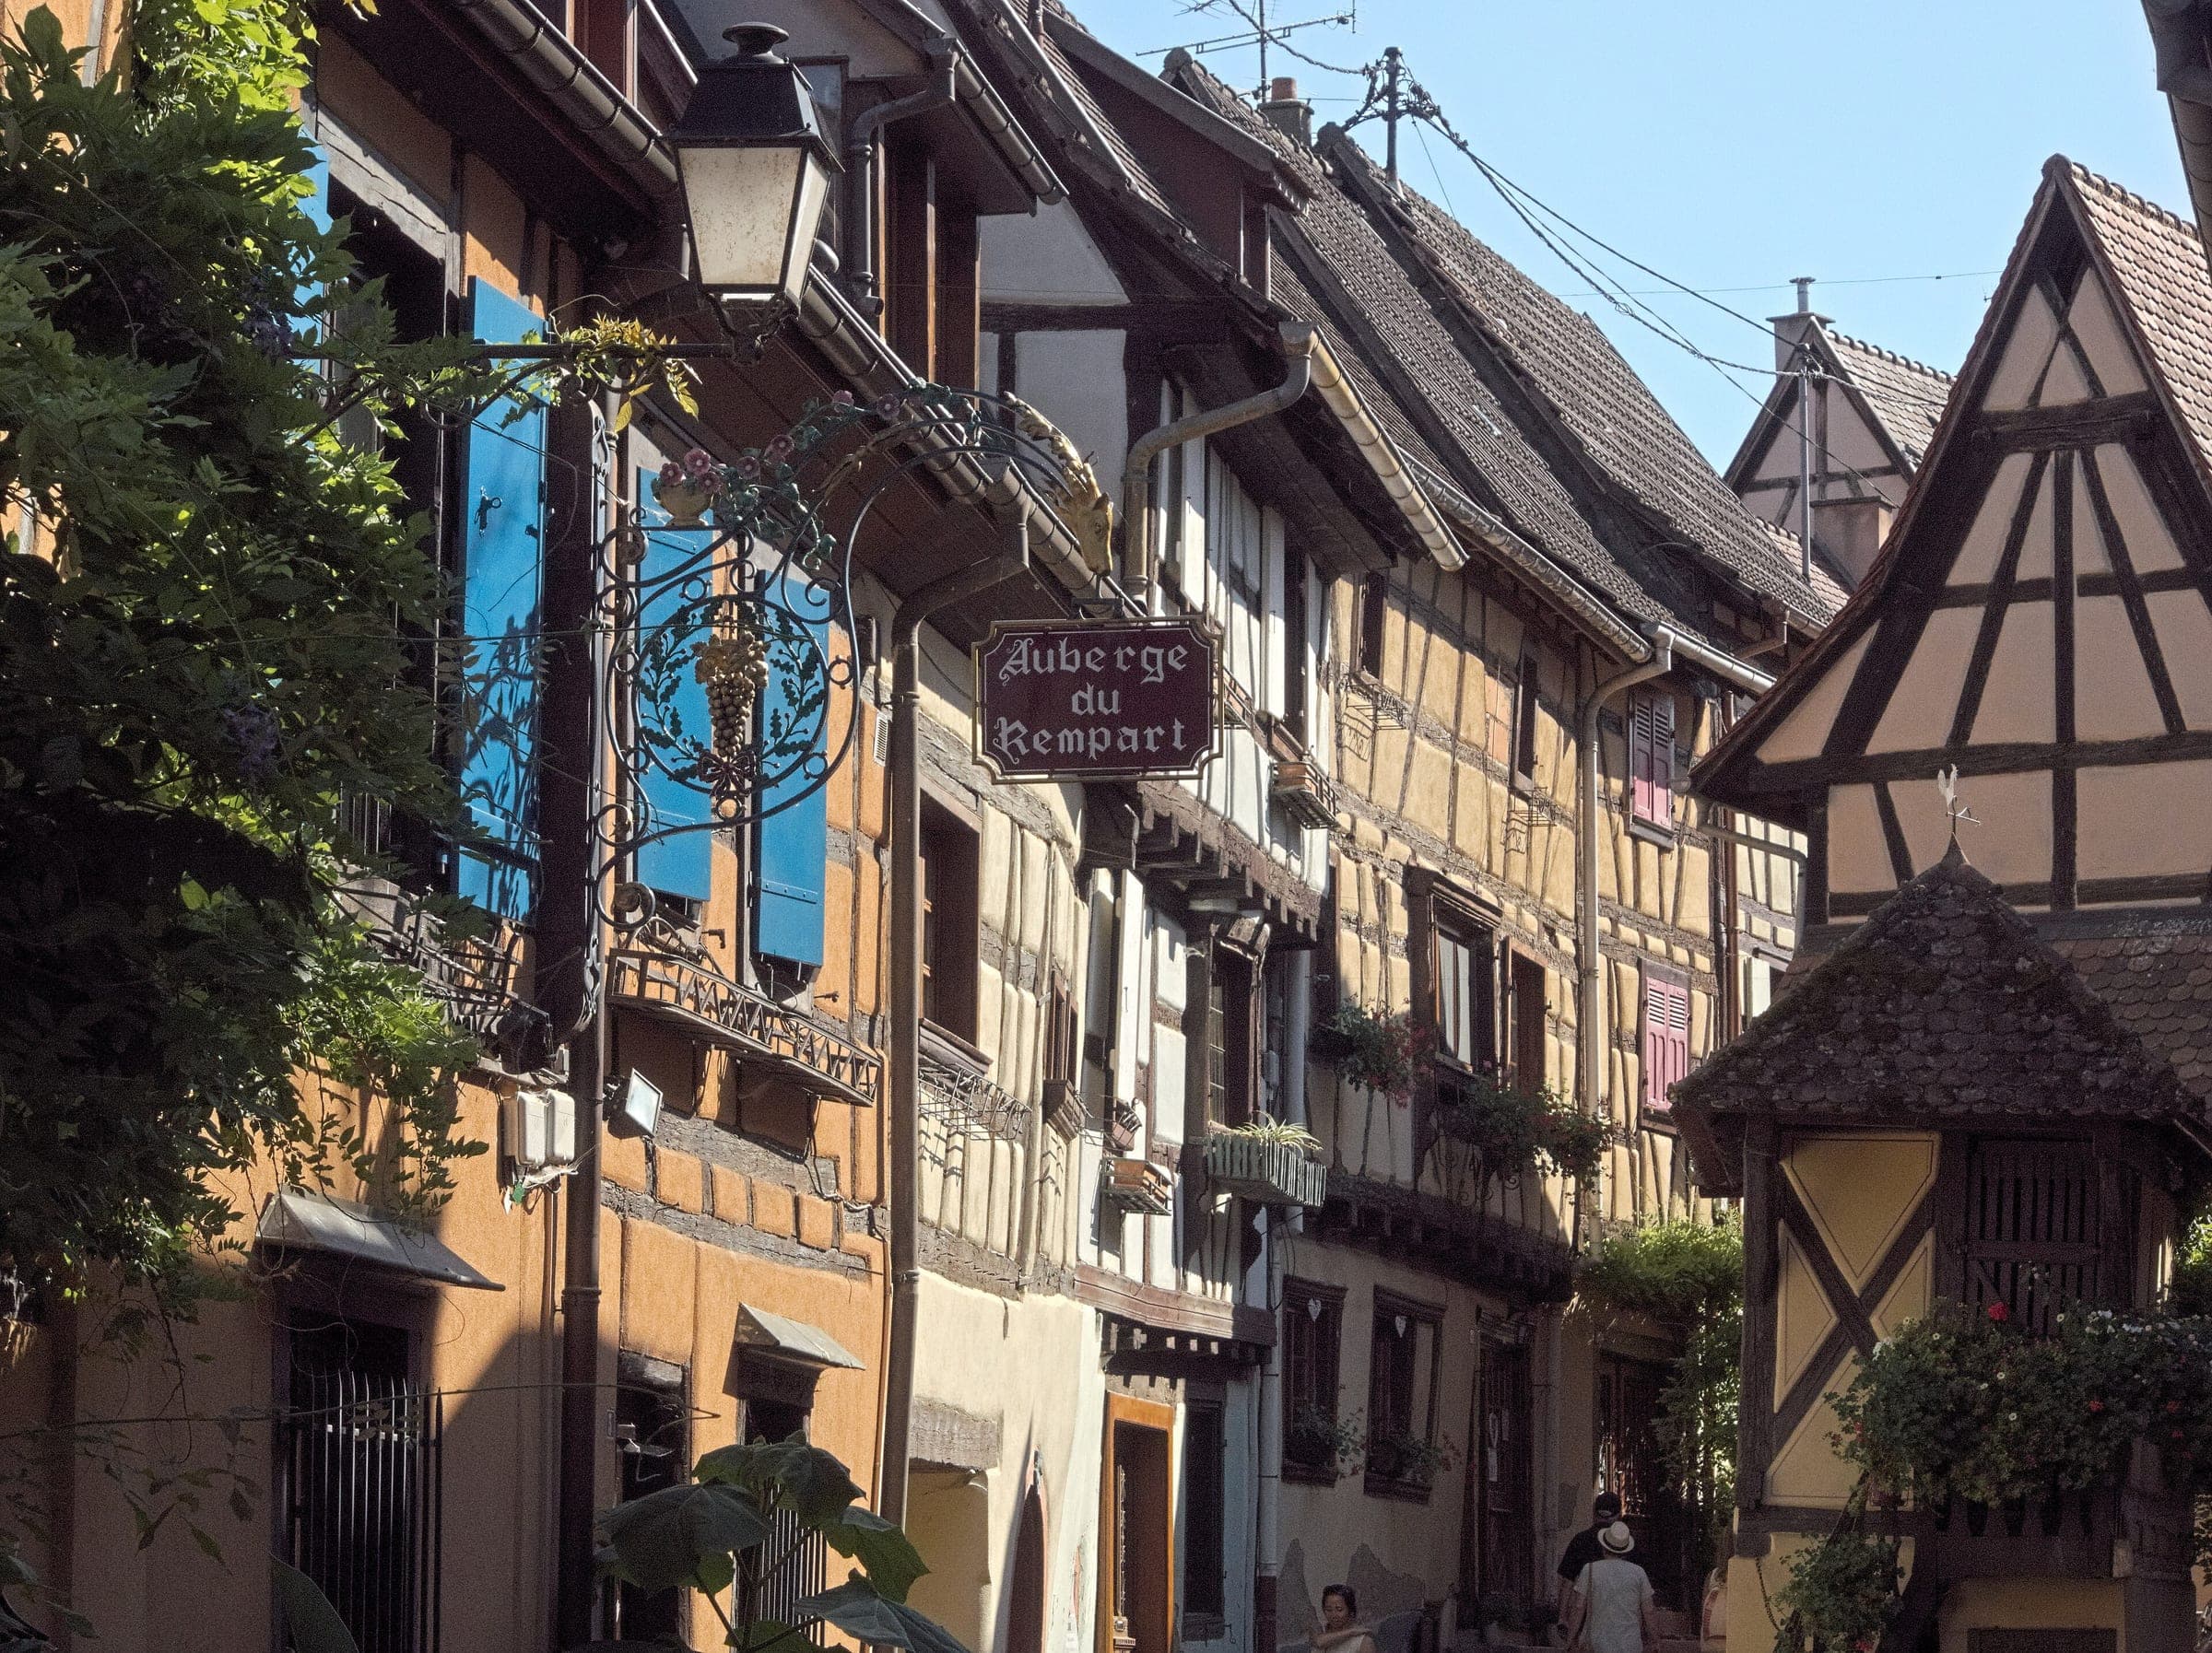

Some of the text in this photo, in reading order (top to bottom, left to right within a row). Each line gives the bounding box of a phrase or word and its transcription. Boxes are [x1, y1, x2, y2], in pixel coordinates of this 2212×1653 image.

[998, 637, 1188, 686] Auberge
[1071, 682, 1121, 716] du
[992, 716, 1187, 765] Rempart
